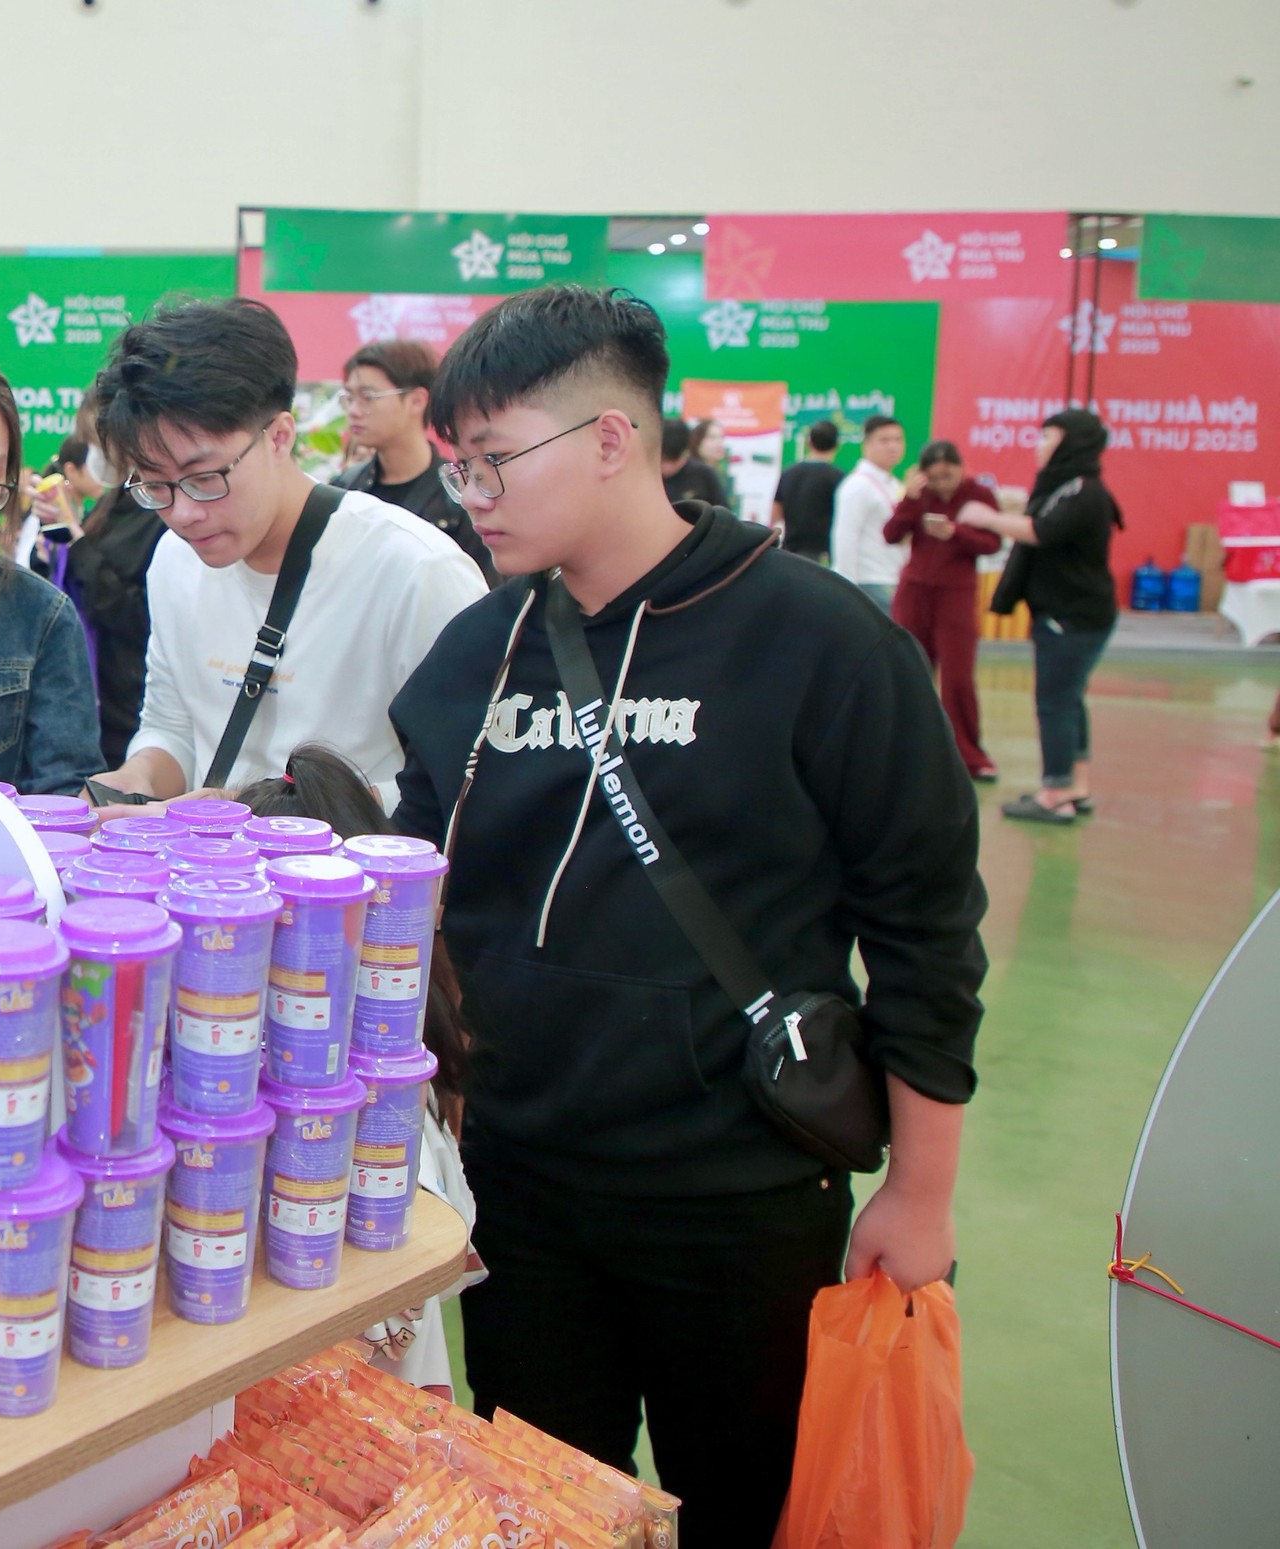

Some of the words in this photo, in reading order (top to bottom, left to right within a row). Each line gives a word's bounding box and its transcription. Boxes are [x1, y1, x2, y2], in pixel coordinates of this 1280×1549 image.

[1106, 399, 1160, 422] THU
[1164, 395, 1203, 423] HÀ
[1209, 396, 1258, 429] NỘI
[1139, 429, 1189, 450] THU
[1194, 429, 1258, 451] 2025
